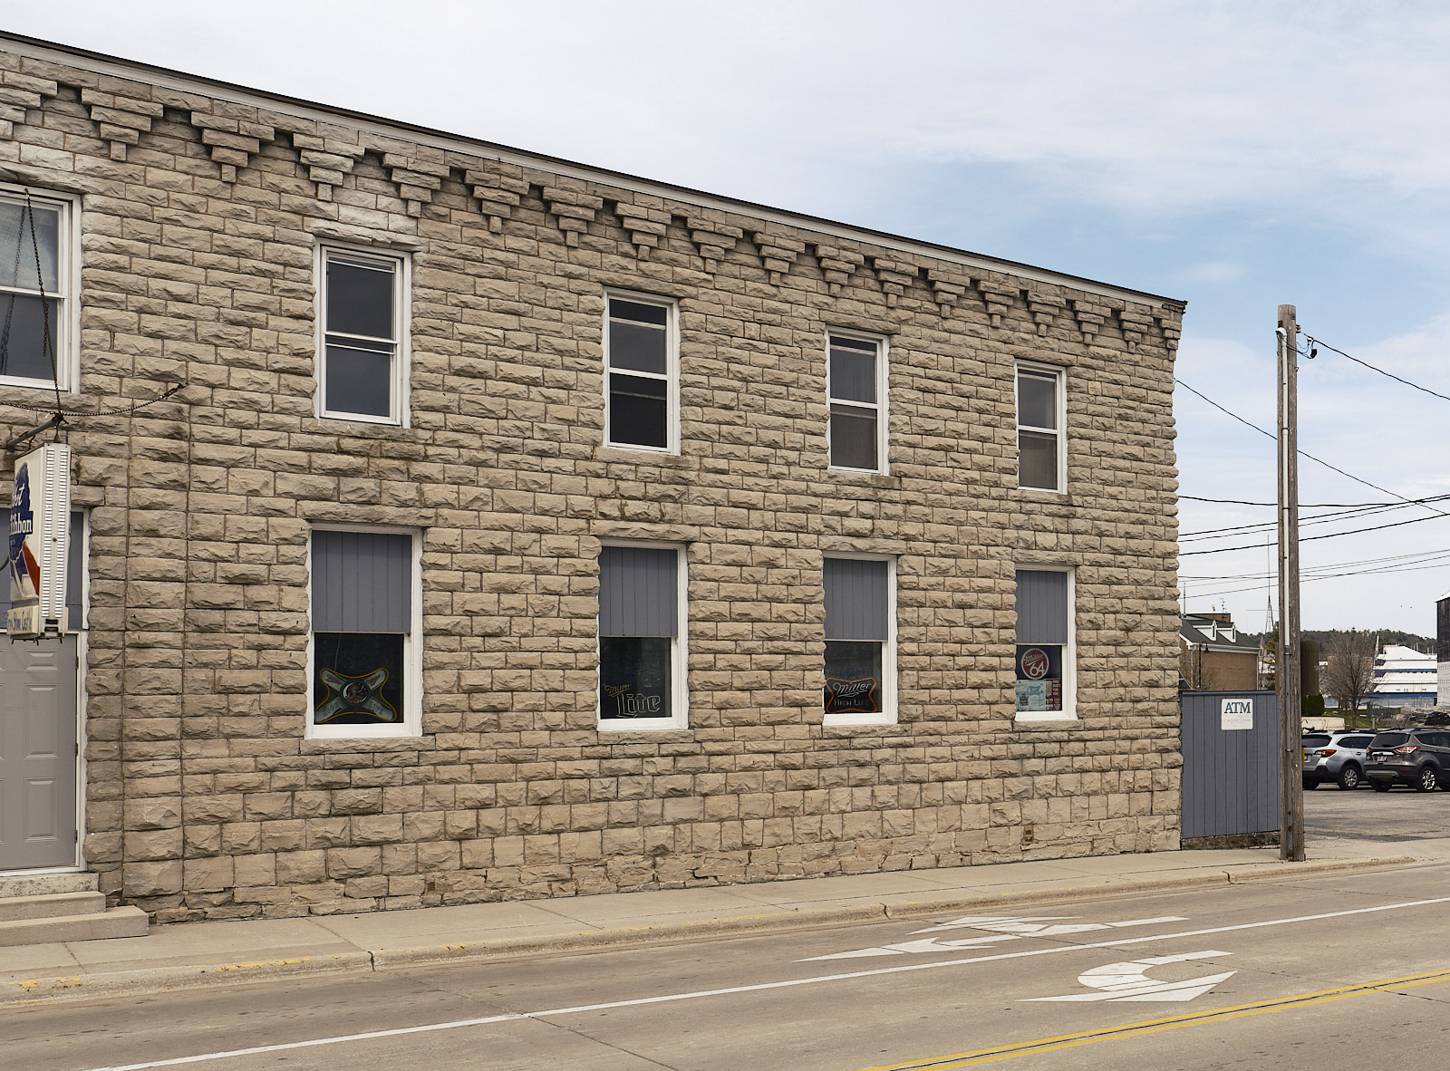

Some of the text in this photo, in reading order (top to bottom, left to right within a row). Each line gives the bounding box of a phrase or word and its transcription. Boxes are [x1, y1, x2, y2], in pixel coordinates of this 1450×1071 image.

[1029, 661, 1045, 676] 64
[832, 682, 872, 697] Miller
[616, 693, 661, 718] Lite
[1224, 701, 1251, 714] ATM
